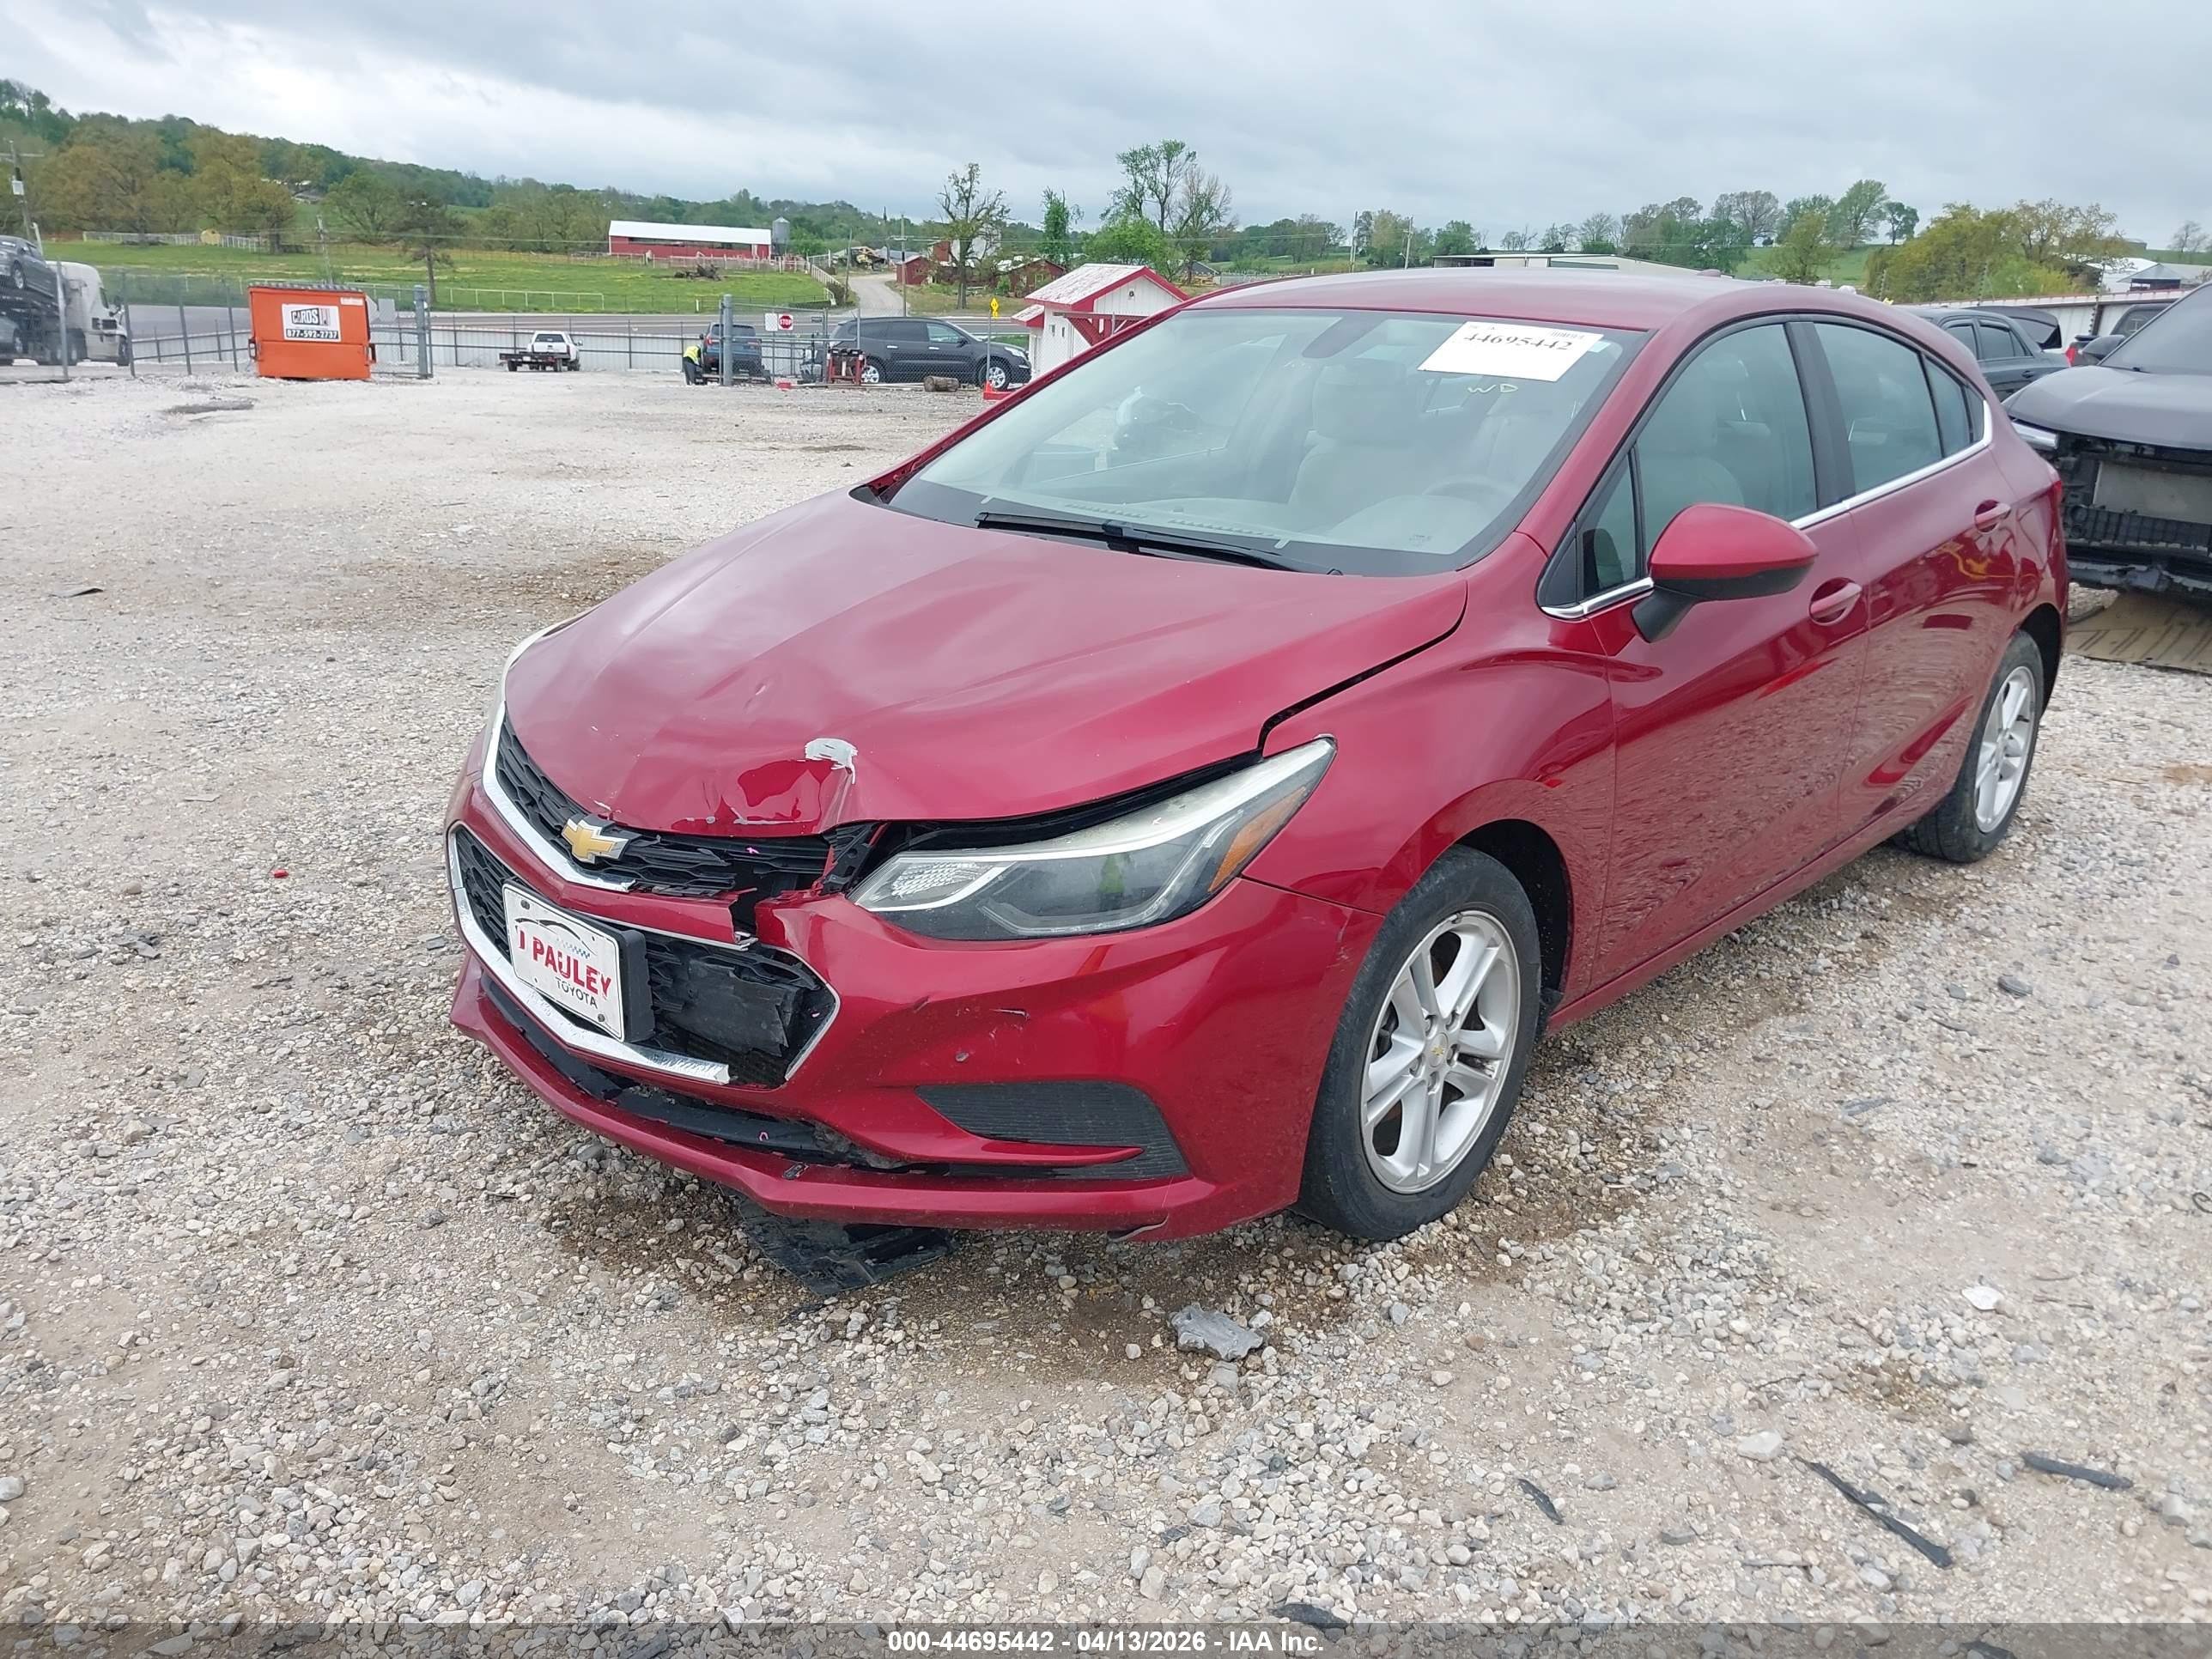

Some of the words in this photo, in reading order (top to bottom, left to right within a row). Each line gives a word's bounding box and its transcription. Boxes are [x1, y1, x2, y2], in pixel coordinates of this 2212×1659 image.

[292, 308, 319, 324] CARDS
[287, 329, 337, 338] 877-592-2737
[1463, 332, 1573, 350] 44695442
[532, 936, 612, 998] PAULEY
[555, 976, 599, 1010] TOYOTA
